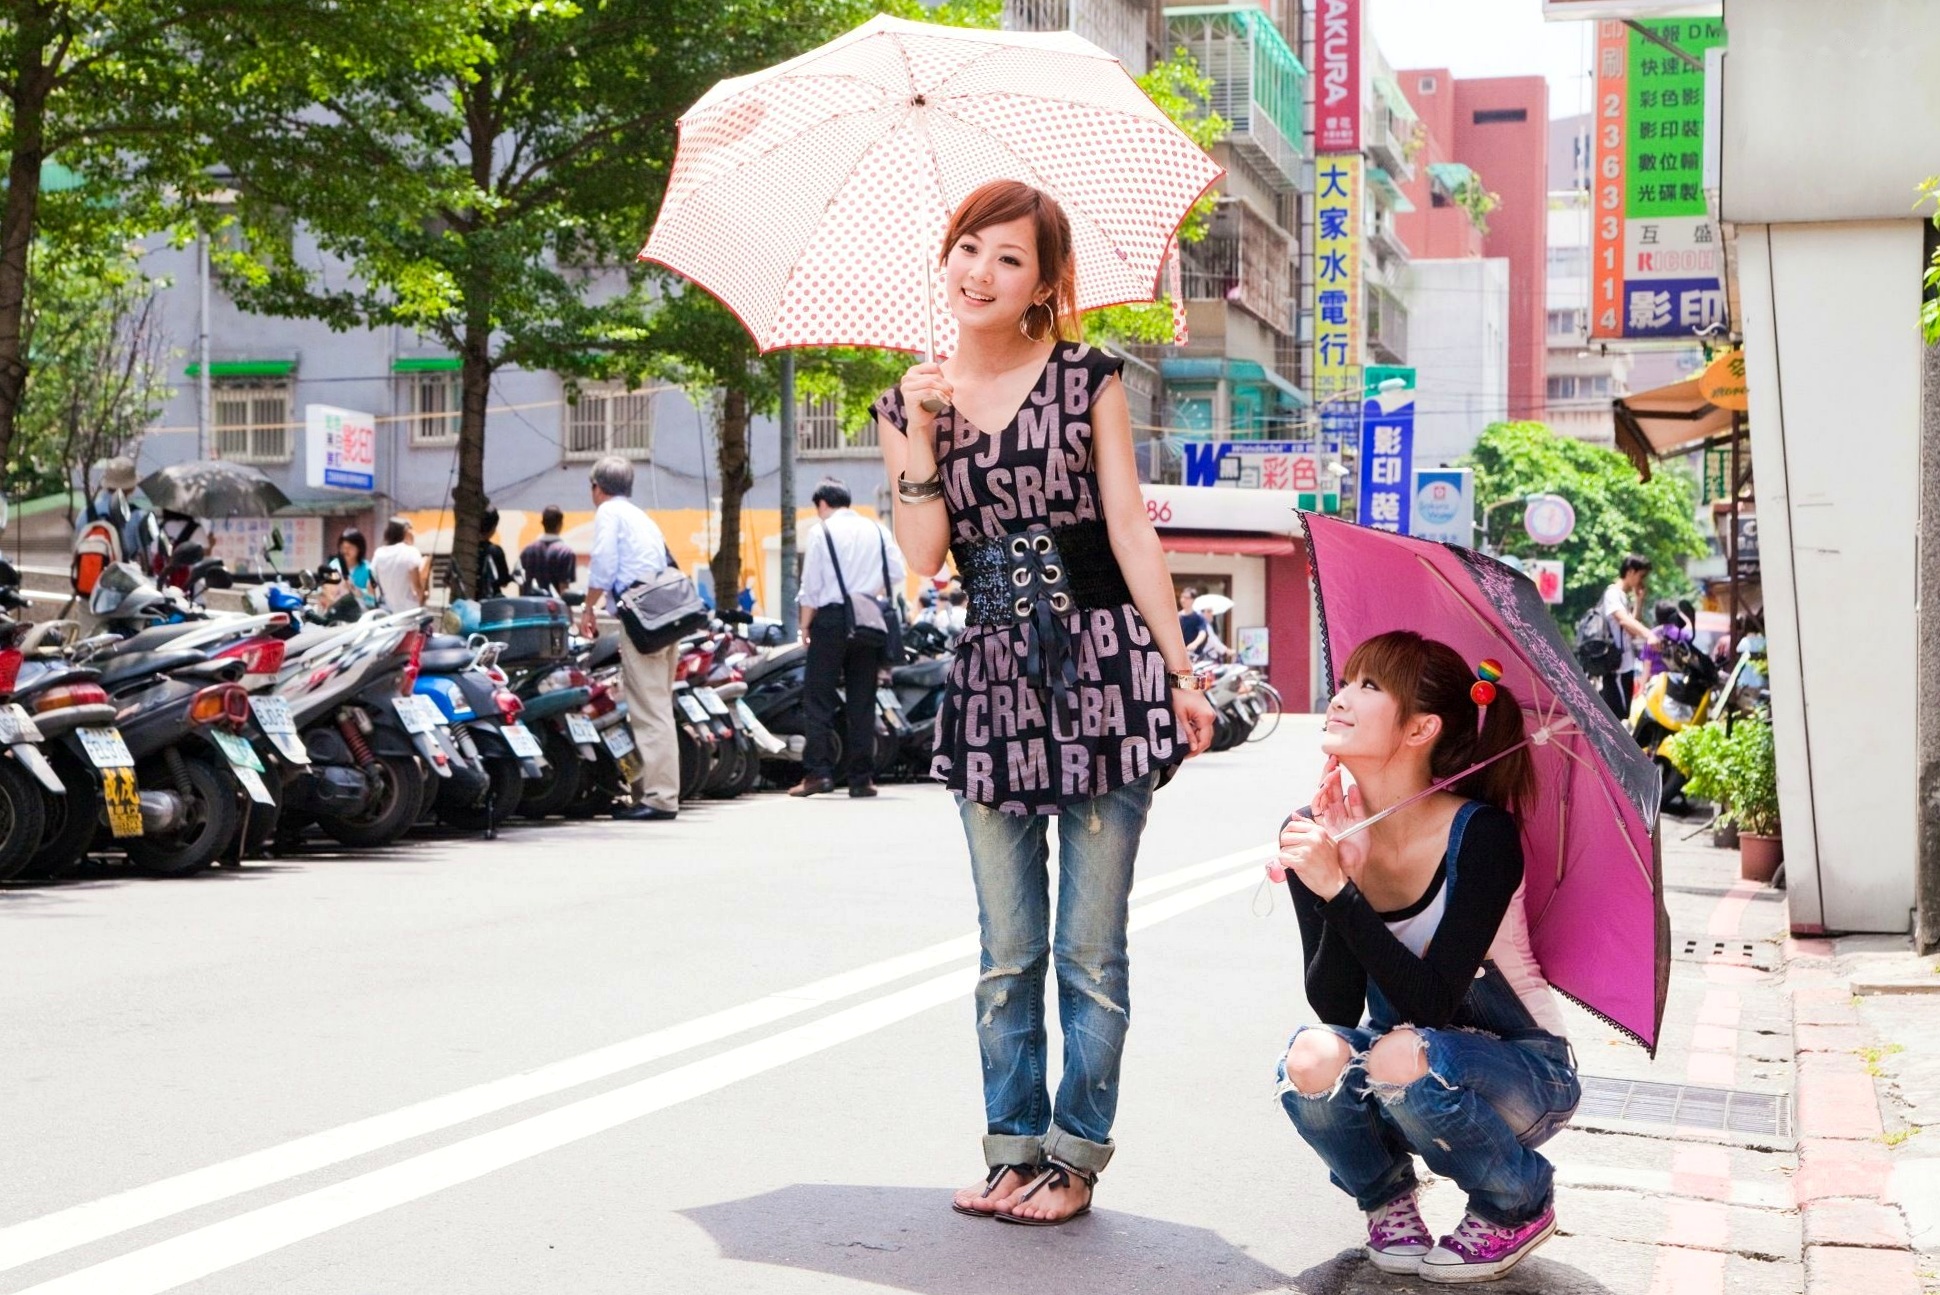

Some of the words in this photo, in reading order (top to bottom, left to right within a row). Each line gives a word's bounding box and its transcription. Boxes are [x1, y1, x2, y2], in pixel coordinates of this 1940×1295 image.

[1319, 164, 1349, 366] 大家水電行
[1628, 288, 1721, 330] 影印
